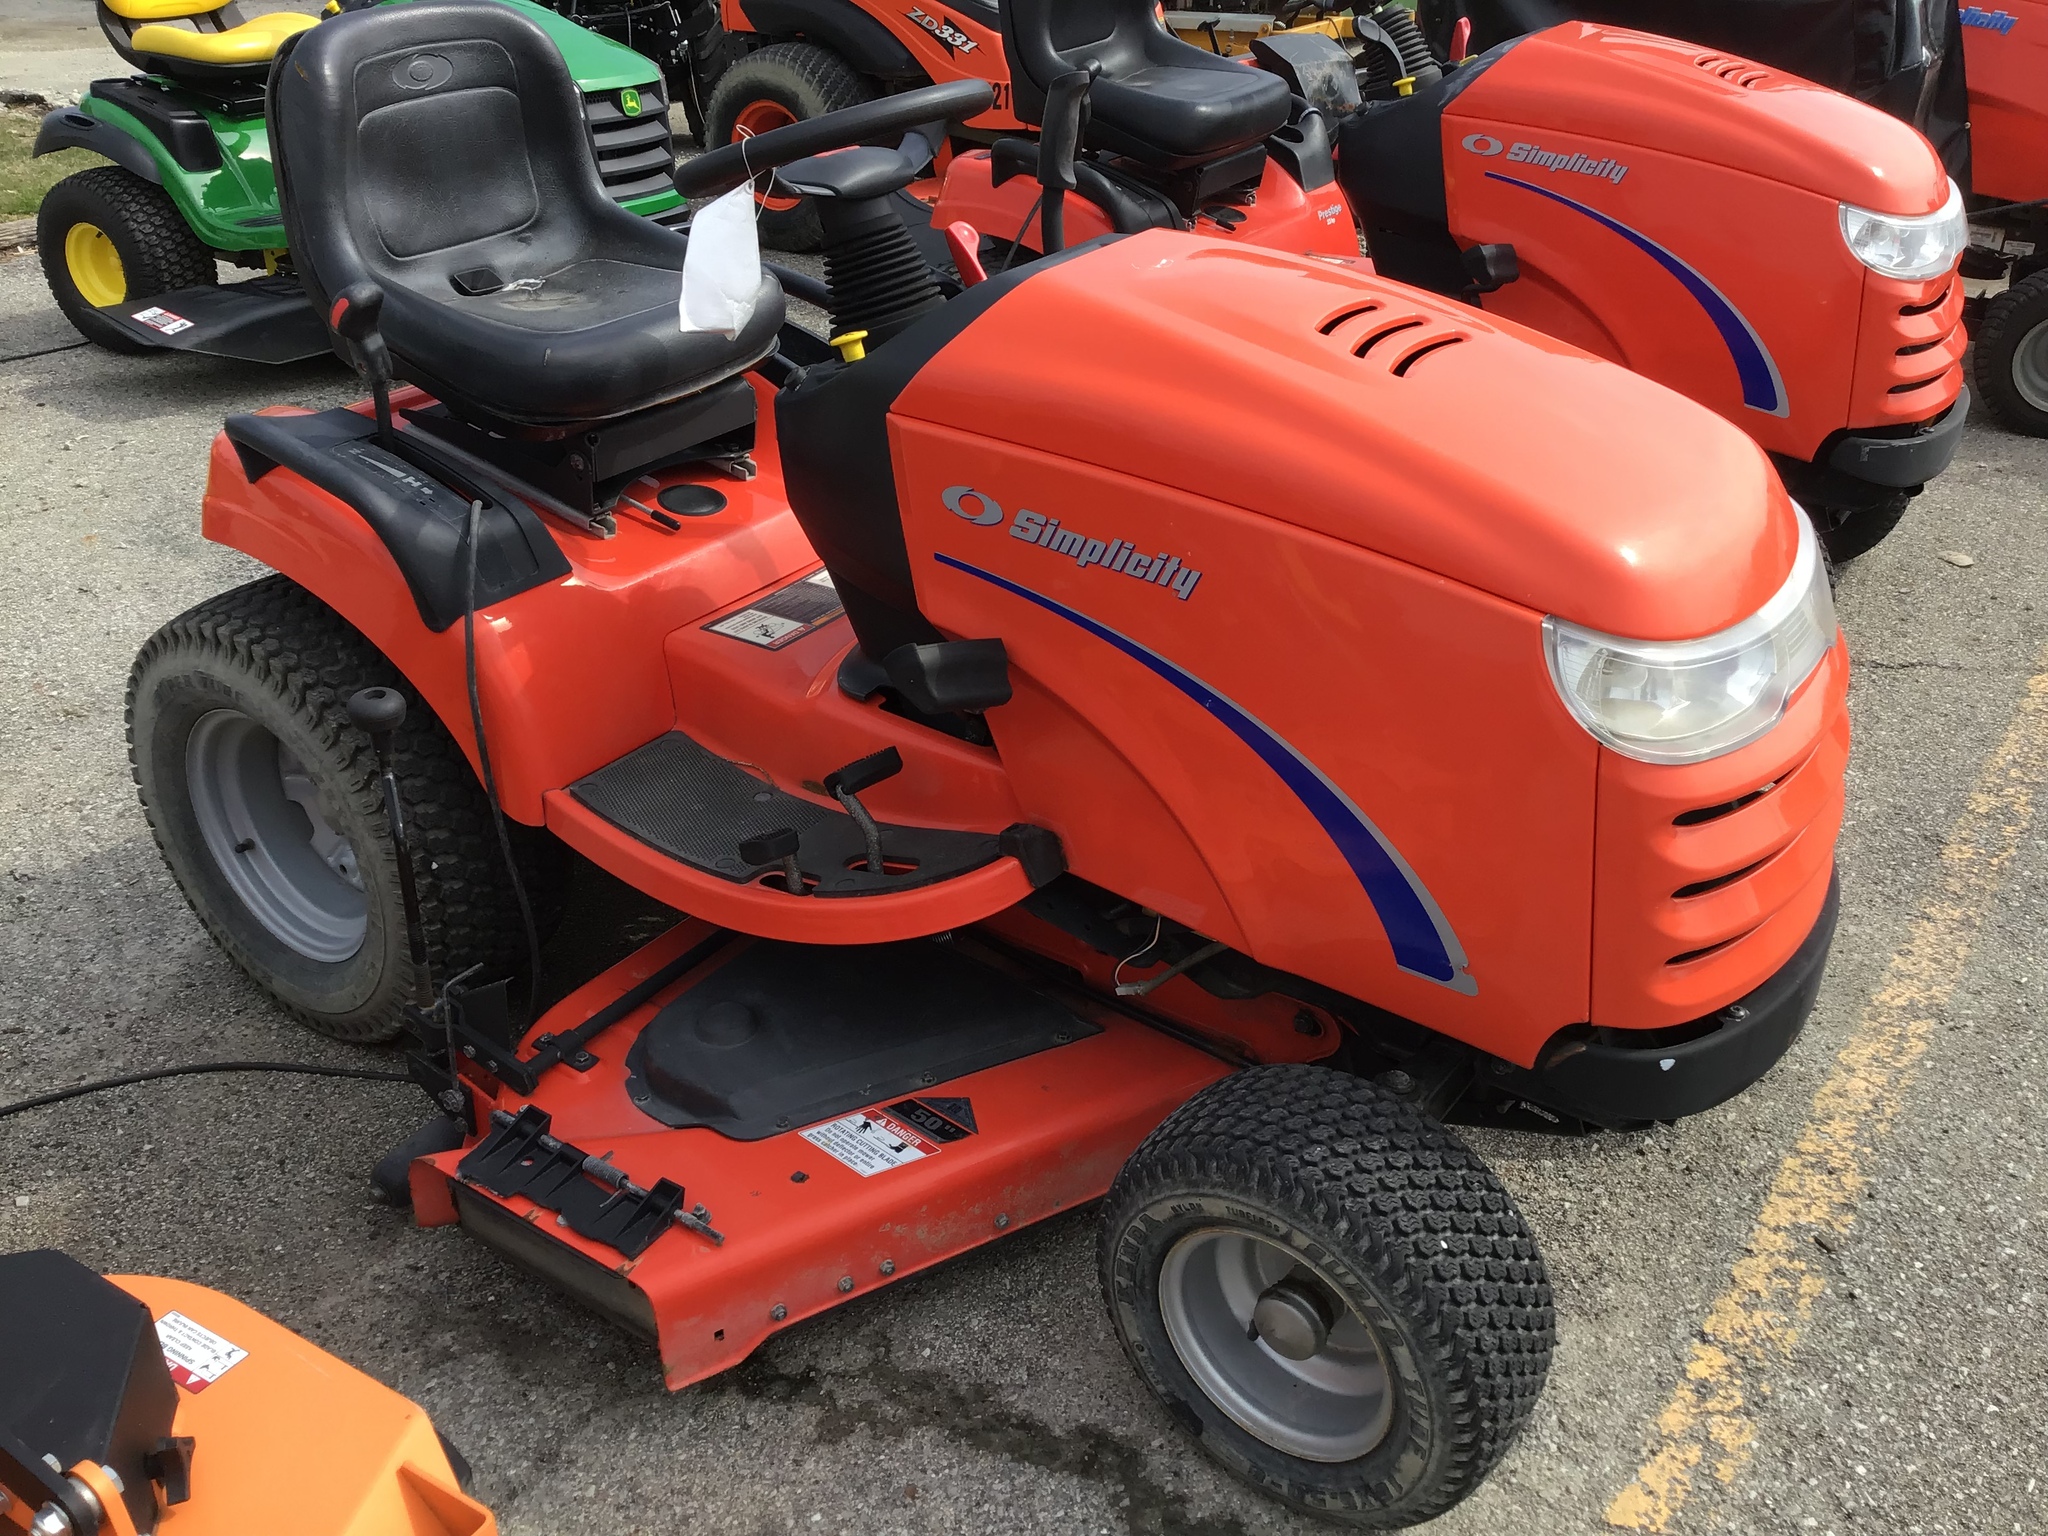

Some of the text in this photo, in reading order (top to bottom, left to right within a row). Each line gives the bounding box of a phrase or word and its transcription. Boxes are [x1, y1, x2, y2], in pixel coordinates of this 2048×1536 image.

[906, 6, 979, 54] ZD331
[1506, 142, 1629, 185] Simplicity
[1318, 203, 1342, 221] Prestige
[1009, 508, 1203, 601] Simplicity
[831, 1123, 897, 1167] ROTATING CUTTING BLADE
[886, 1123, 921, 1147] DANGER
[816, 1130, 834, 1143] without
[833, 1141, 854, 1156] deflector
[860, 1158, 875, 1169] entire
[840, 1137, 858, 1150] operate
[857, 1148, 875, 1161] mower
[1114, 1212, 1163, 1305] KENDA
[160, 1319, 178, 1332] THROWN
[187, 1326, 198, 1334] CAN
[165, 1334, 192, 1351] KEEP CLEAR
[181, 1331, 202, 1346] CONTACT
[196, 1331, 217, 1345] OBJECTS
[200, 1343, 216, 1354] BLADE
[166, 1346, 195, 1365] SPINNING
